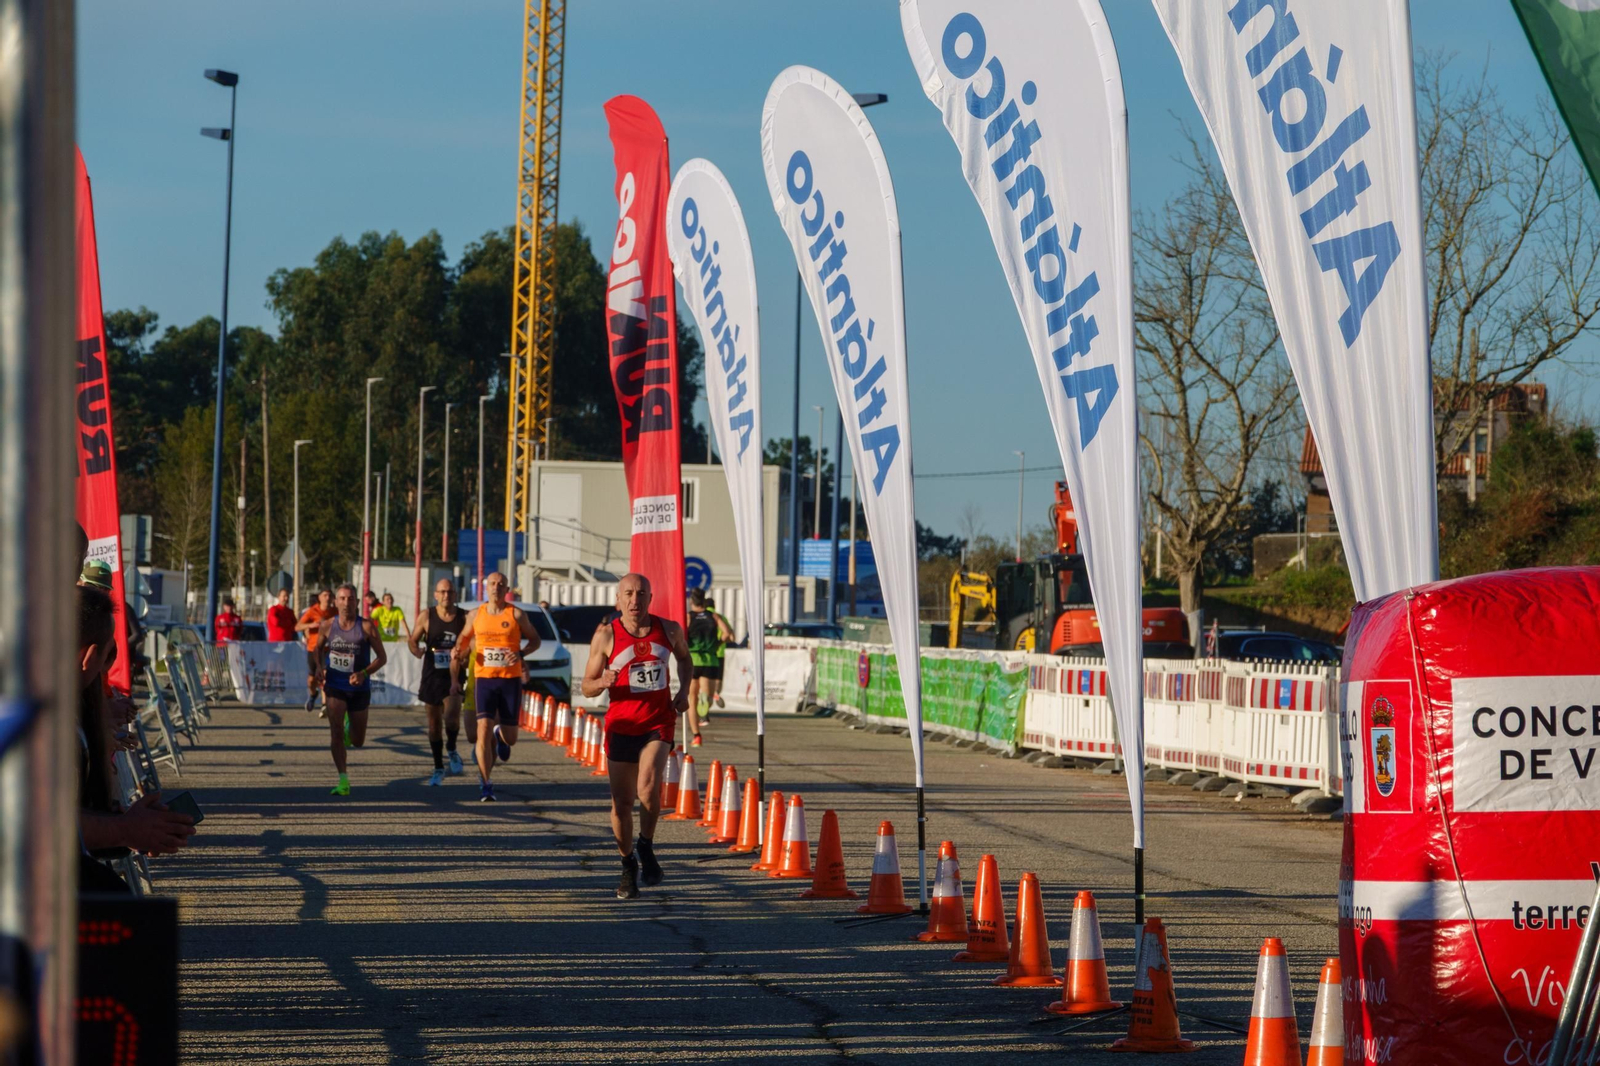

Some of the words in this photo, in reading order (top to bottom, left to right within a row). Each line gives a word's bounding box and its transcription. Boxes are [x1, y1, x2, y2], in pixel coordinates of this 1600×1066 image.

[333, 657, 349, 667] 315
[487, 652, 506, 661] 327
[637, 668, 662, 684] 317
[1500, 749, 1553, 780] DE
